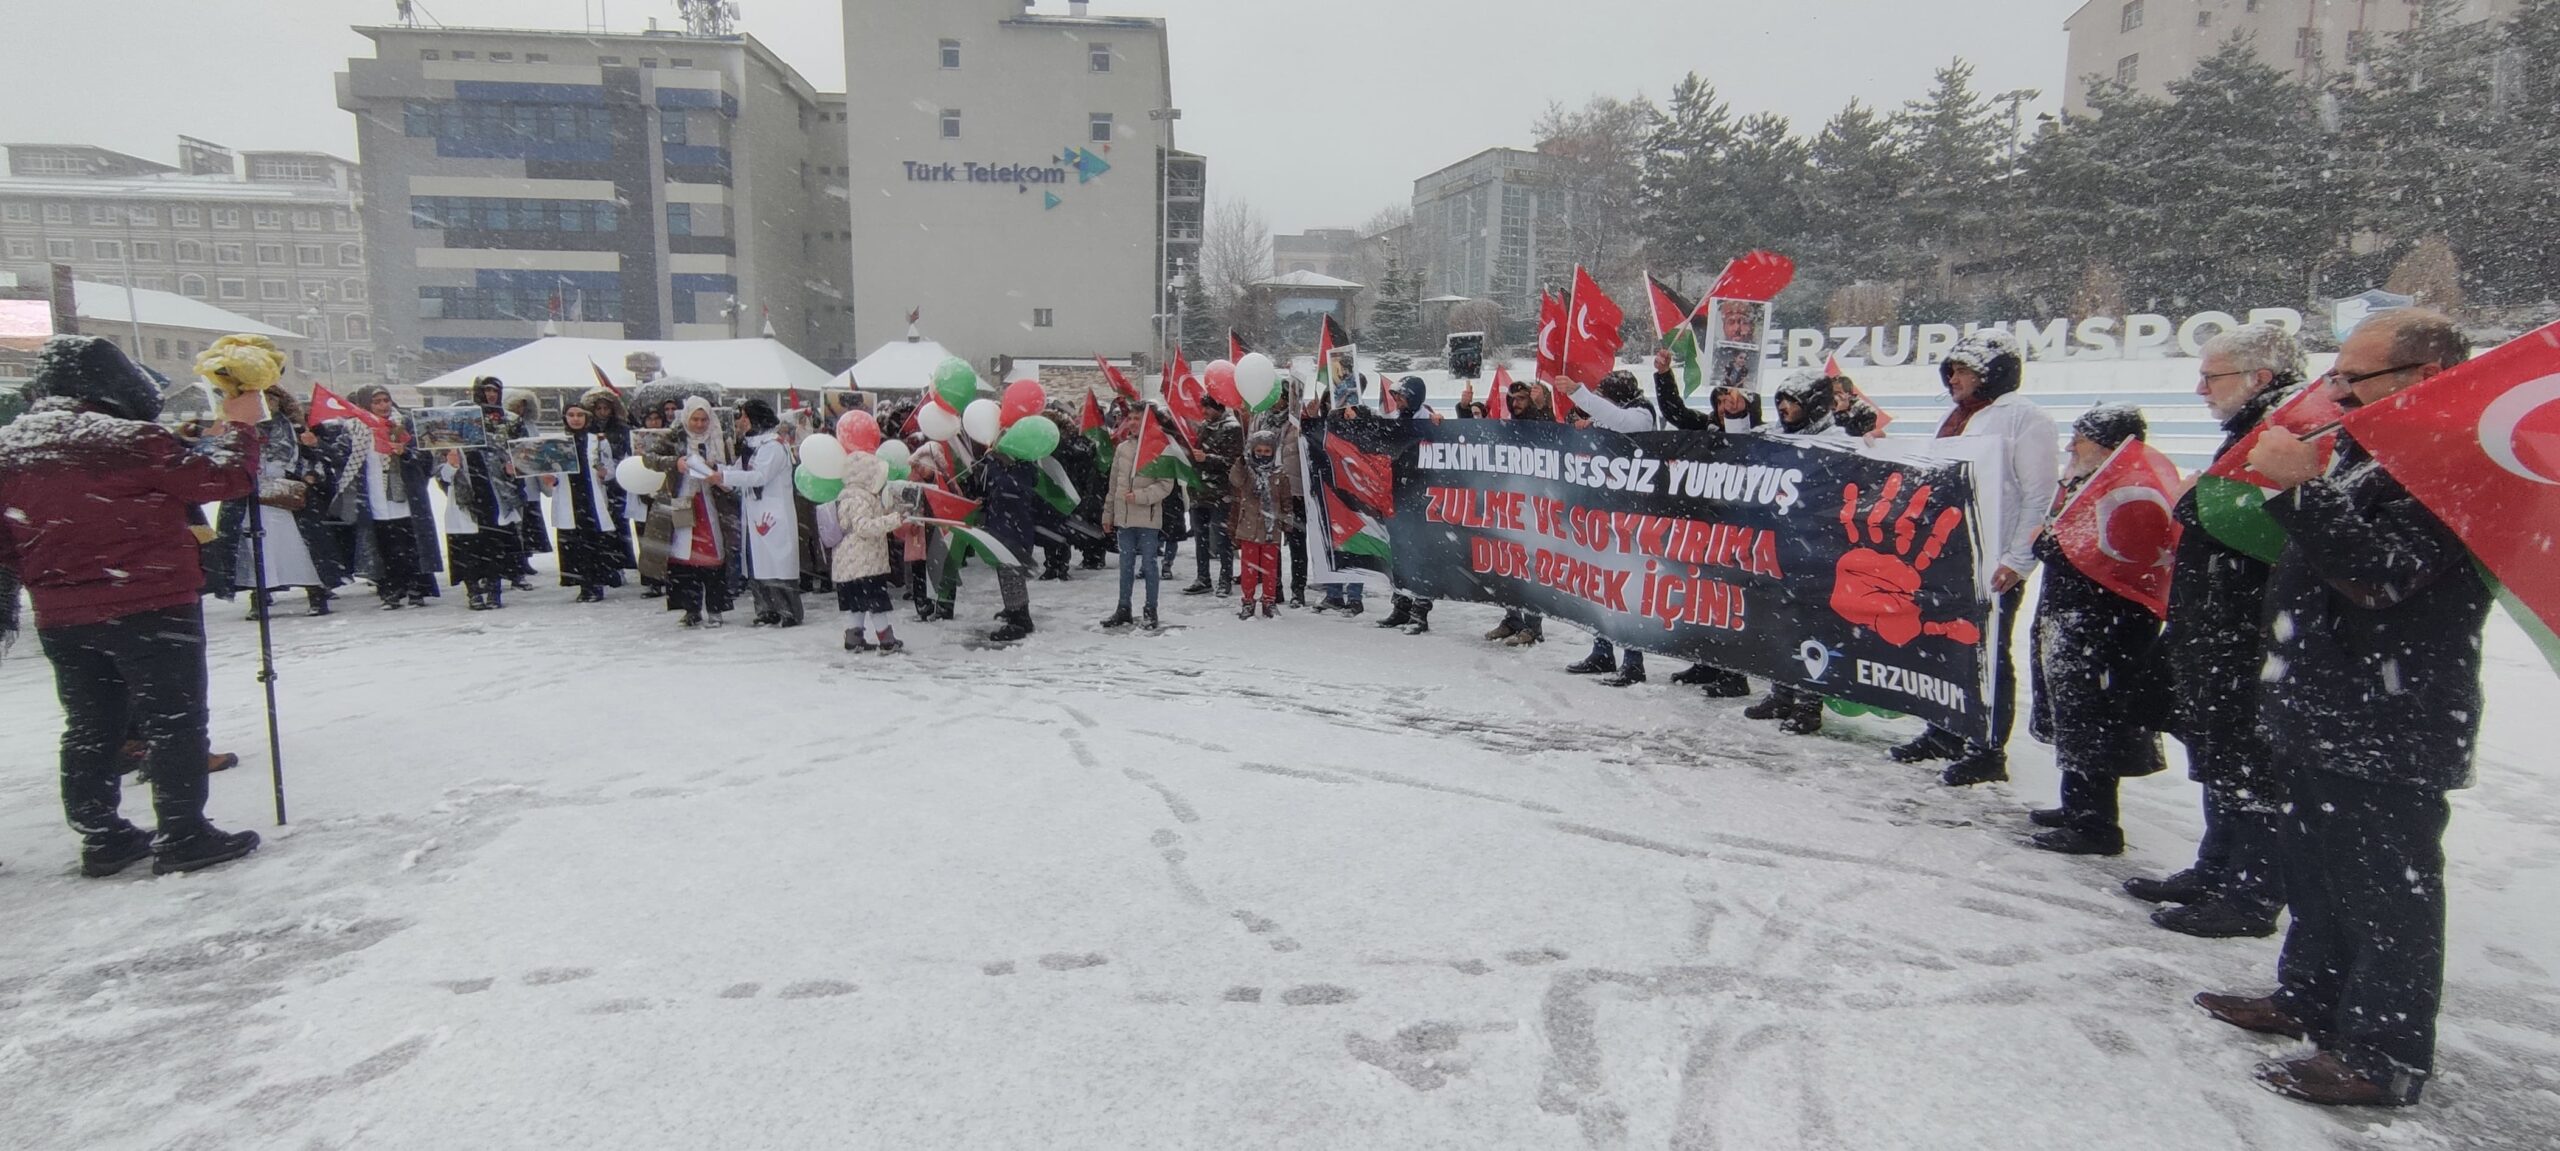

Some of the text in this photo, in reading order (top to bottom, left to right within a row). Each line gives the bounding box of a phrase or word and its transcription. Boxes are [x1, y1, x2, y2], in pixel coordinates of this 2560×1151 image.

[903, 161, 1065, 183] Türk Telekom
[1763, 308, 2301, 369] ERZURMSPO
[1418, 435, 1559, 480] HEKİMLERDEN
[1564, 449, 1660, 493] SESSİZ
[1425, 486, 1784, 580] ZULME VE SOYKIRIMA
[1471, 536, 1745, 631] DUR DEMEK İÇİN!
[1856, 658, 1967, 694] ERZURUM
